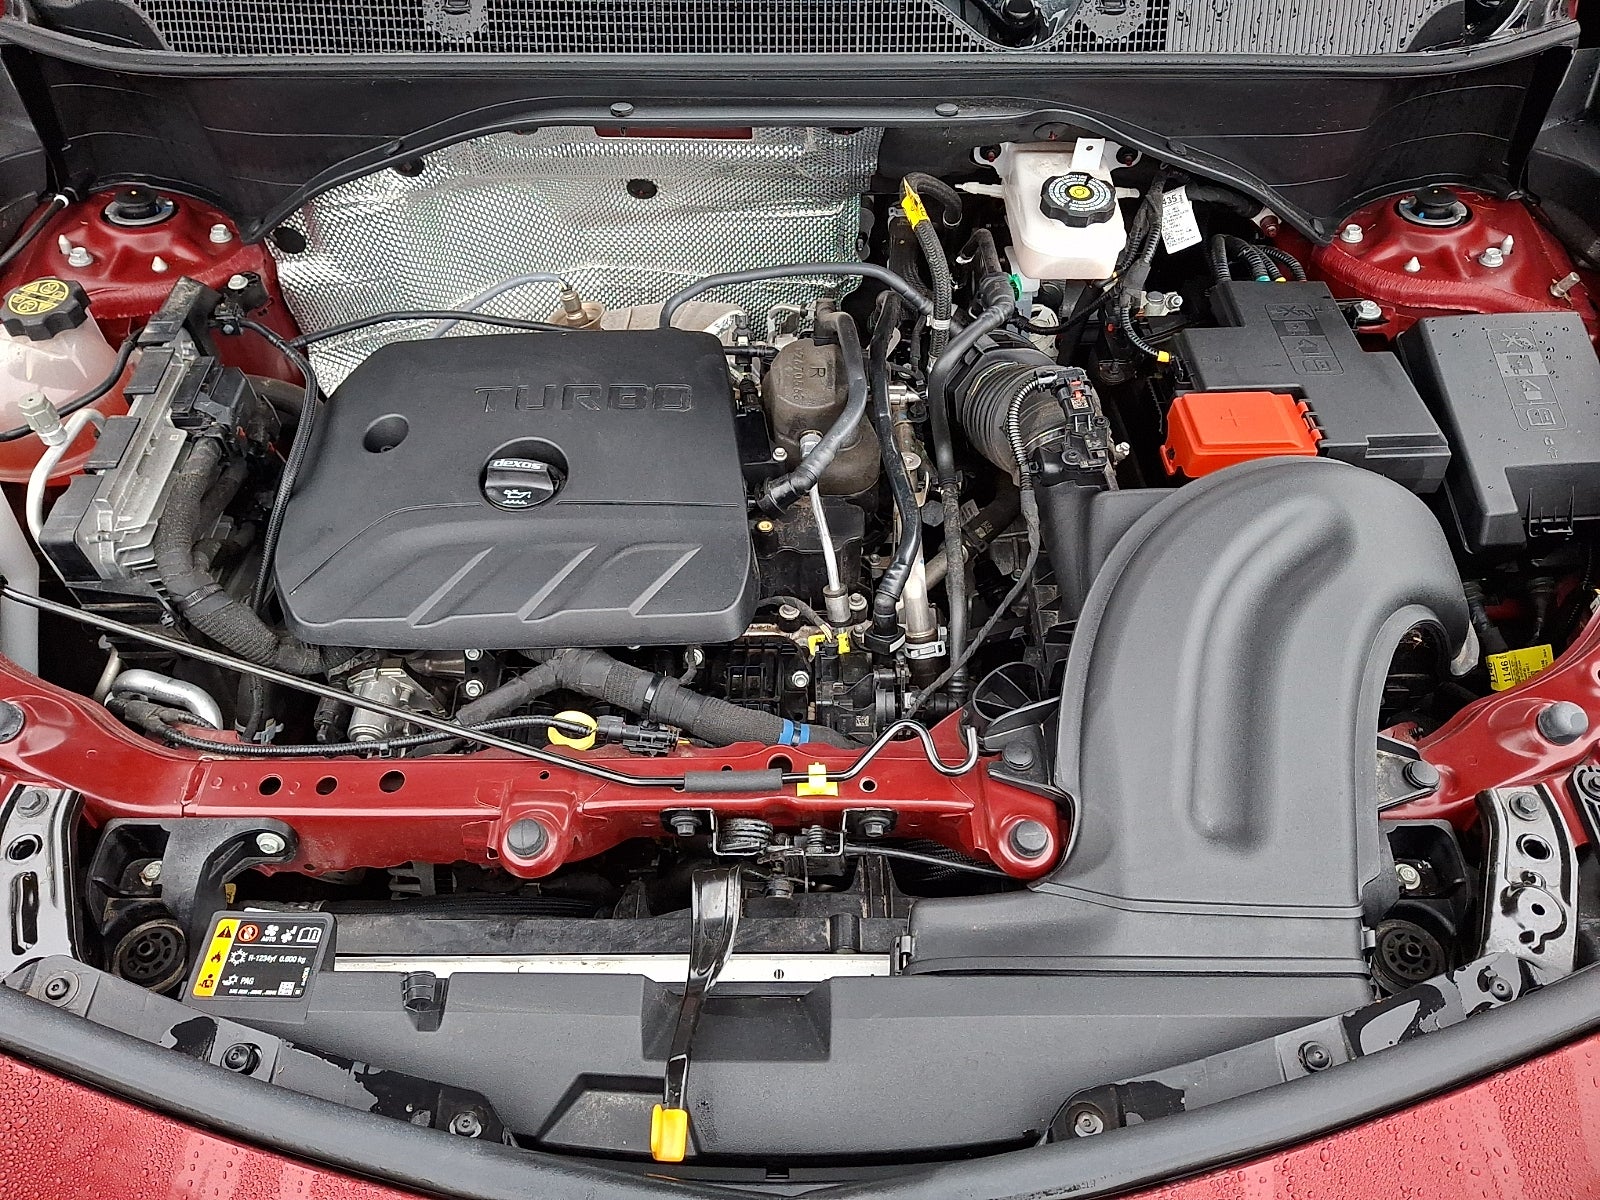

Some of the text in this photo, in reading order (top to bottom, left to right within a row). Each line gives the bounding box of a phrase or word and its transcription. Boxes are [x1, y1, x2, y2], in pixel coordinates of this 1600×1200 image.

[810, 366, 826, 378] R
[475, 384, 692, 412] TURBO
[493, 459, 543, 470] dexos
[1501, 660, 1511, 682] 1146
[240, 977, 254, 985] PAG
